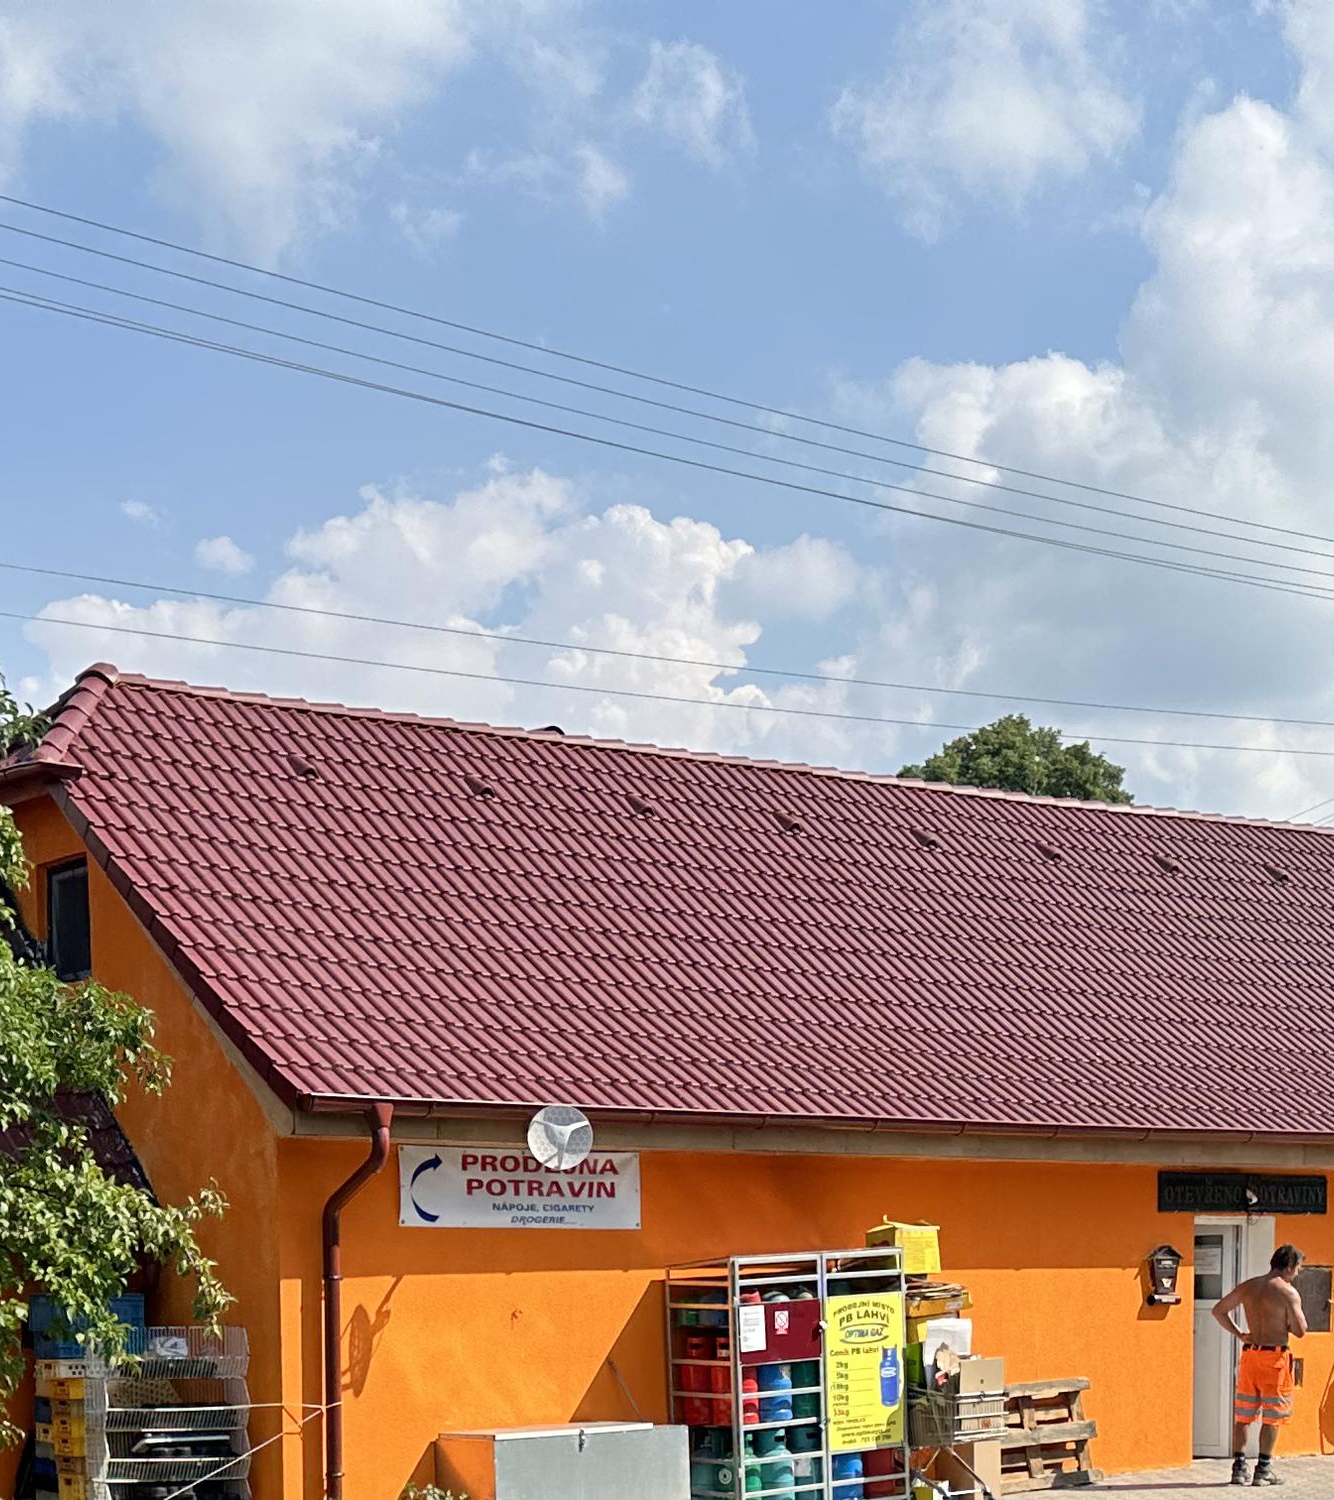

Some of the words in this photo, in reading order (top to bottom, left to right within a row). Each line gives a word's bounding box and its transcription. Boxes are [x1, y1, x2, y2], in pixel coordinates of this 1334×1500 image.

[461, 1153, 620, 1176] PRODNA
[466, 1178, 616, 1198] POTRAVIN
[542, 1203, 595, 1213] CIGARETY
[839, 1313, 853, 1327] PB
